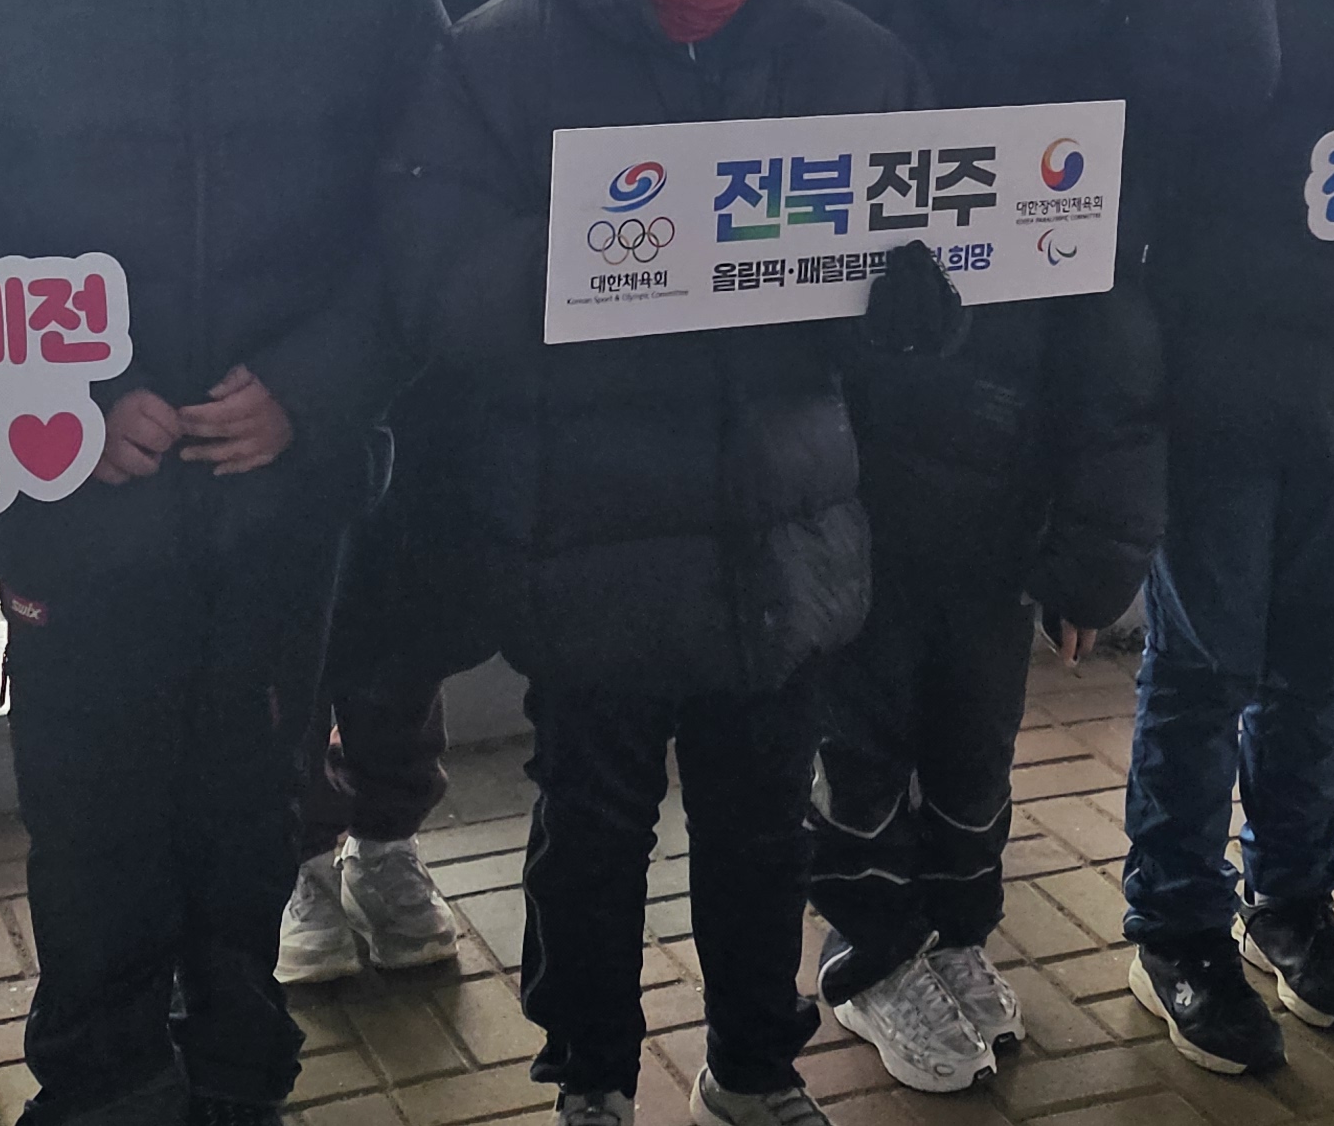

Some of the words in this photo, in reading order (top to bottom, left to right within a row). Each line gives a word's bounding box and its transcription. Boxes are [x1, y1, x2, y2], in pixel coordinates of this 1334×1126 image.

[712, 154, 853, 243] 전북
[866, 146, 997, 232] 전주
[1016, 196, 1103, 216] 대한장애인체육회
[947, 243, 994, 272] 희망
[590, 270, 668, 293] 대한체육회
[11, 599, 42, 620] swix
